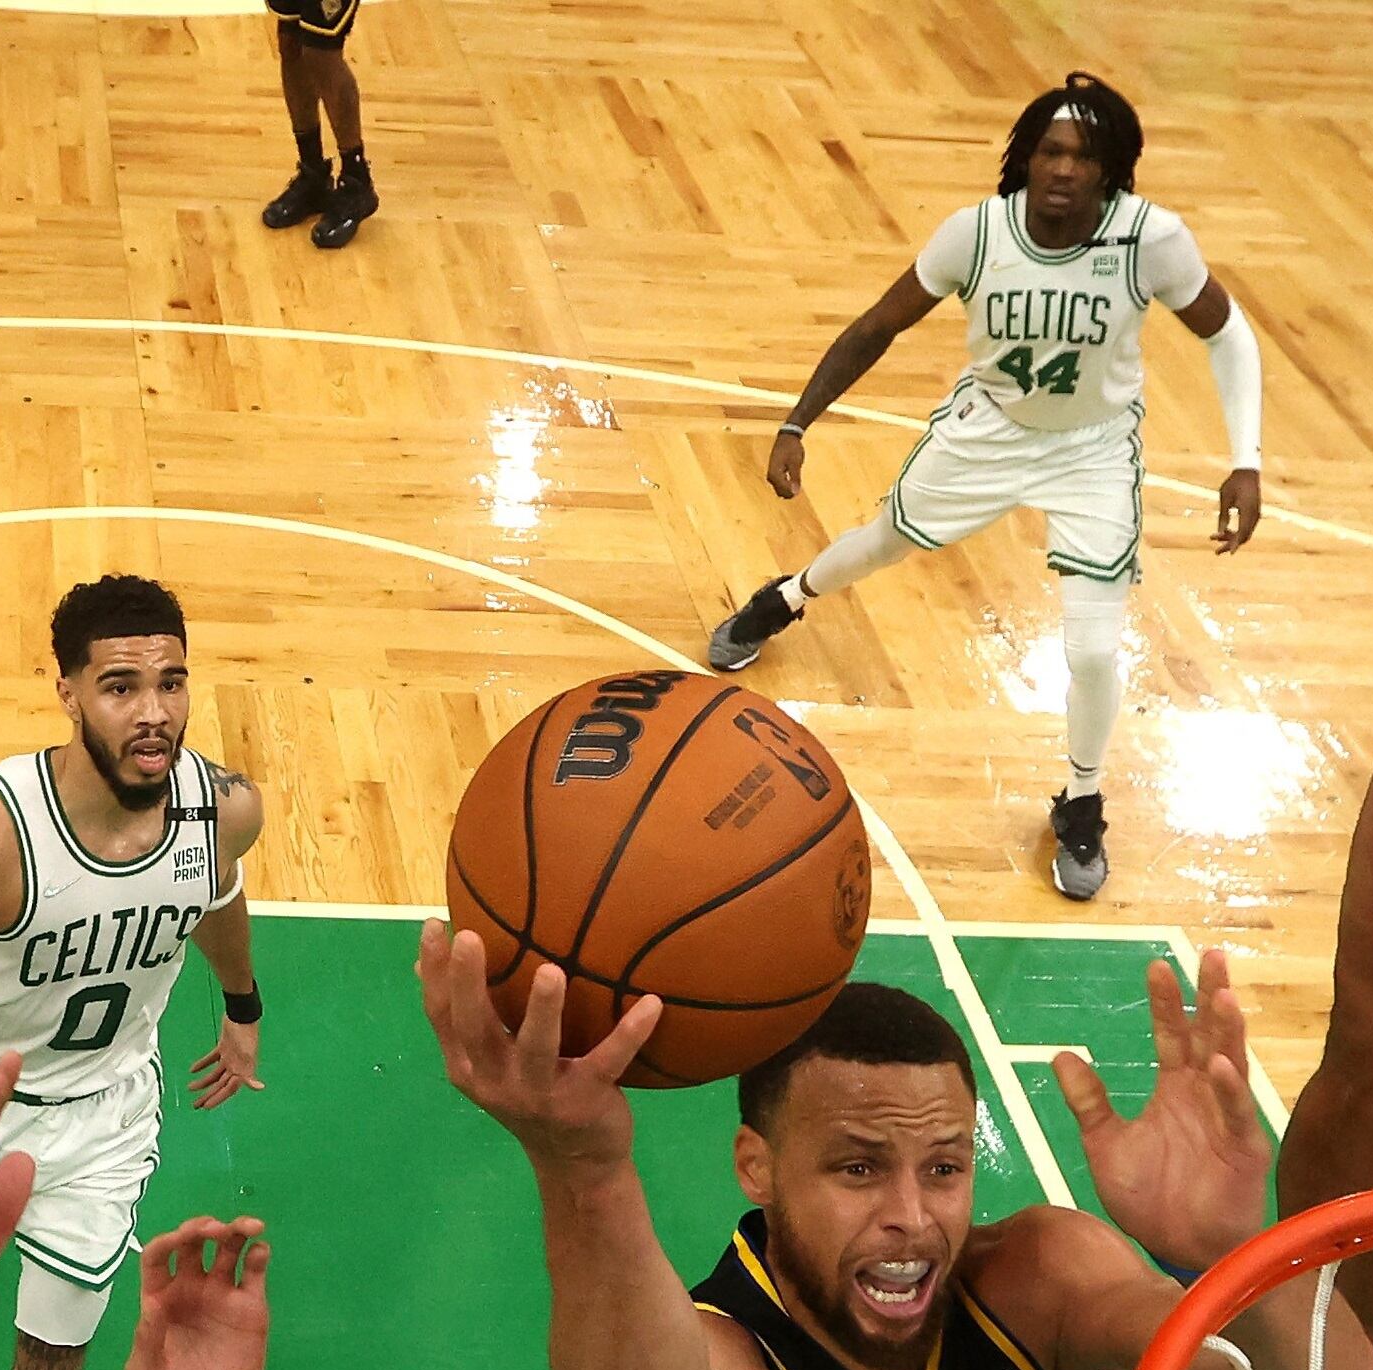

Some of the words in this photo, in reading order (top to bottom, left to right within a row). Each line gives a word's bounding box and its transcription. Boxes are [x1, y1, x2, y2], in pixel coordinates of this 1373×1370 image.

[987, 287, 1111, 345] CELTICS
[997, 345, 1081, 395] 44
[552, 669, 686, 785] Wil
[173, 846, 205, 868] VISTA
[173, 863, 205, 883] PRINT
[19, 905, 202, 987] CELTICS
[47, 982, 132, 1051] 0
